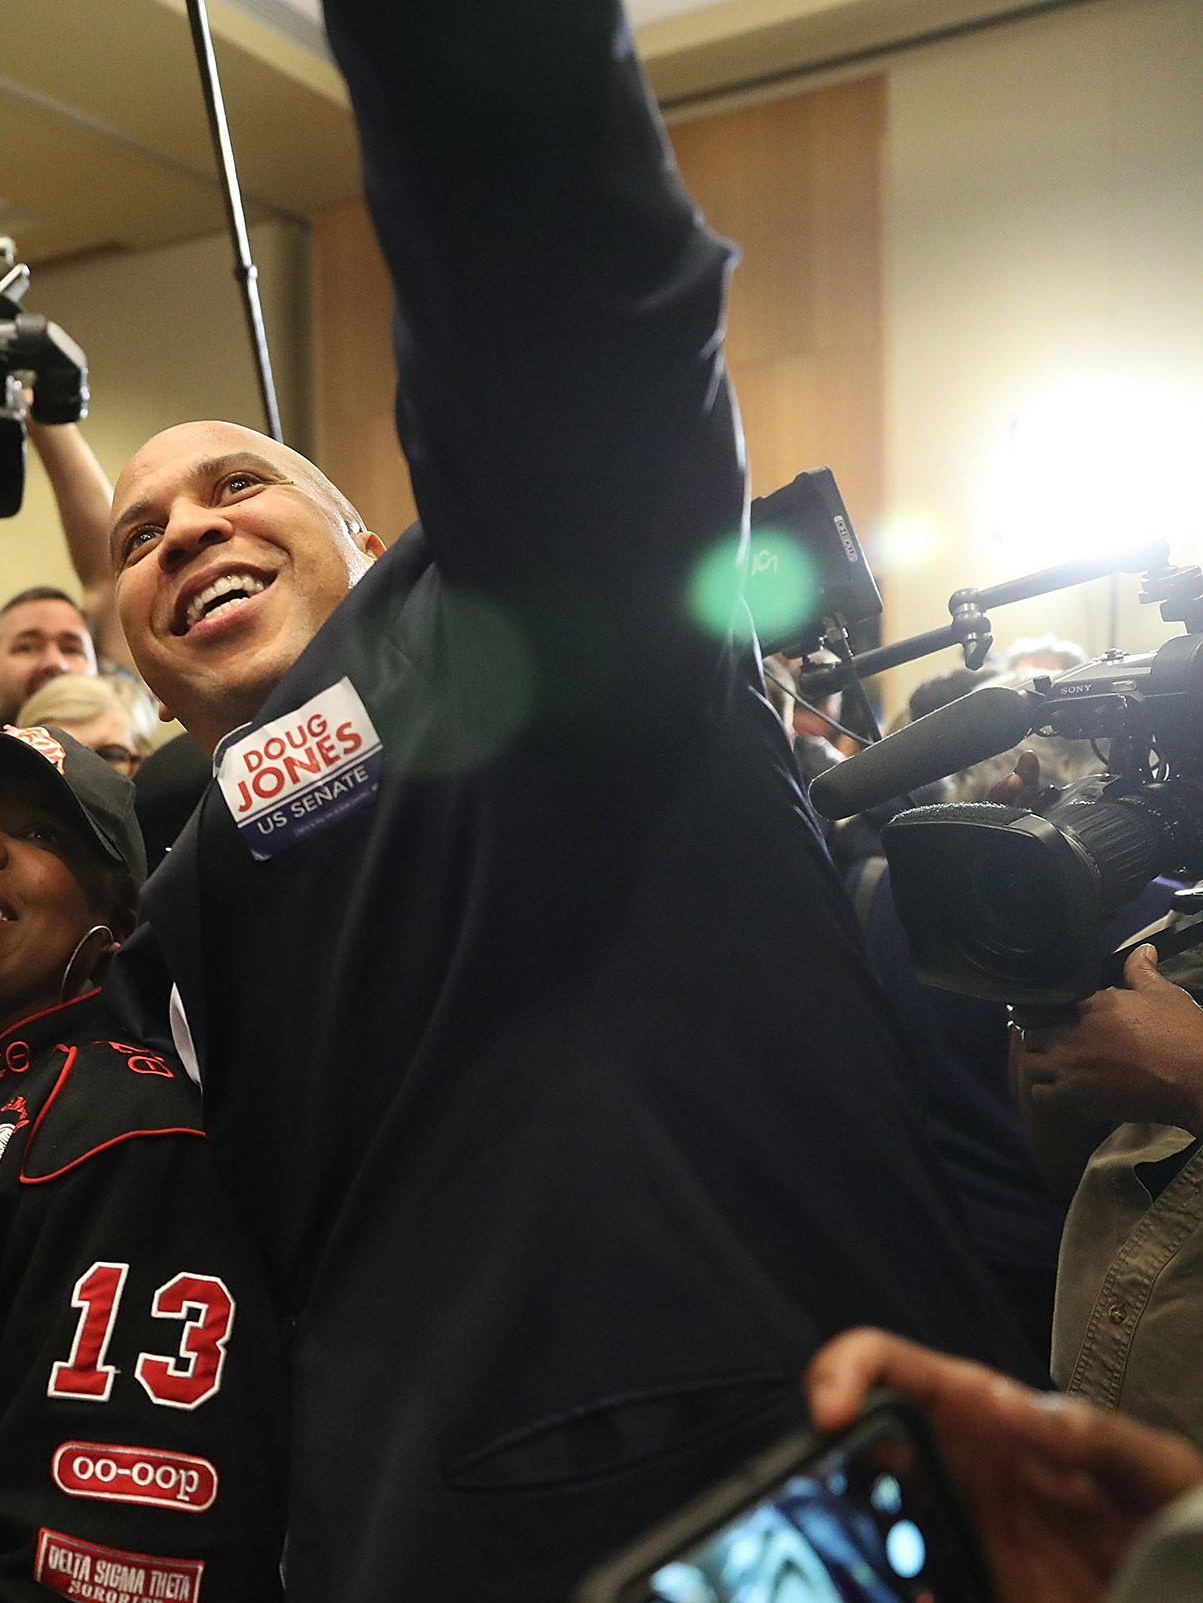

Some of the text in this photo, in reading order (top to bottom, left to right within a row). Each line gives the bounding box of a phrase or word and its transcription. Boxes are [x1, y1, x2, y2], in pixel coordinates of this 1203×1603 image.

[1060, 684, 1092, 695] SONY
[237, 721, 362, 812] JONES
[243, 714, 327, 773] DOUG
[257, 811, 287, 835] US
[290, 765, 369, 818] SENATE
[48, 1262, 236, 1409] 13
[72, 1456, 200, 1501] oo-oop
[48, 1545, 191, 1602] DELTA SIGMA THETA
